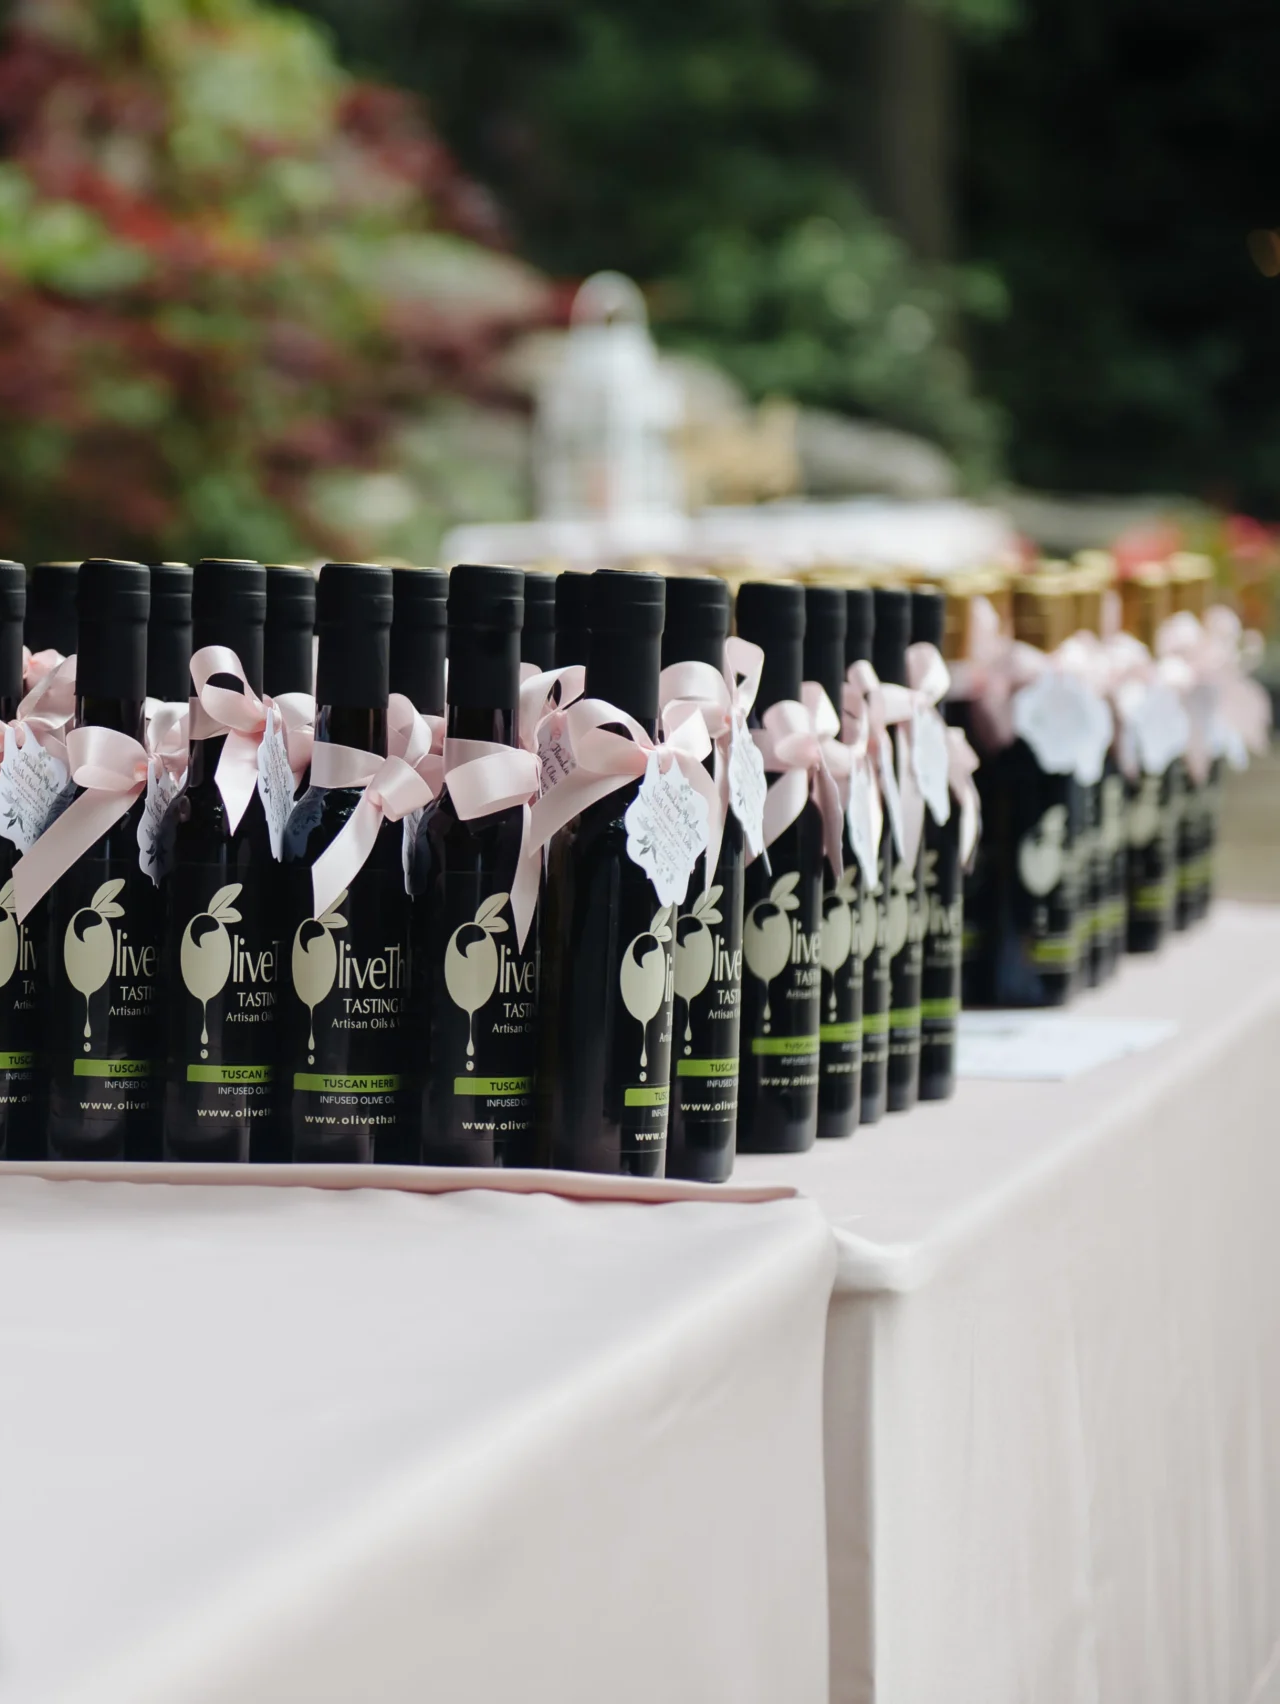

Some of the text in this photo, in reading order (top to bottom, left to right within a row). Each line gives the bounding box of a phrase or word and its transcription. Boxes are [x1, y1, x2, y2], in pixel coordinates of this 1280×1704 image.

[108, 1005, 142, 1016] Artisan
[342, 998, 399, 1015] TASTING
[225, 1011, 260, 1022] Artisan
[707, 1009, 734, 1021] Artisan
[331, 1018, 368, 1030] Artisan
[370, 1018, 388, 1030] Oils
[491, 1023, 523, 1034] Artisan
[221, 1069, 262, 1080] TUSCAN
[323, 1078, 394, 1089] TUSCAN HERB
[489, 1081, 527, 1092] TUSCAN
[217, 1086, 254, 1095] INFUSED
[319, 1095, 359, 1105] INFUSED
[360, 1095, 384, 1105] OLIVE
[486, 1098, 520, 1108] INFUSED
